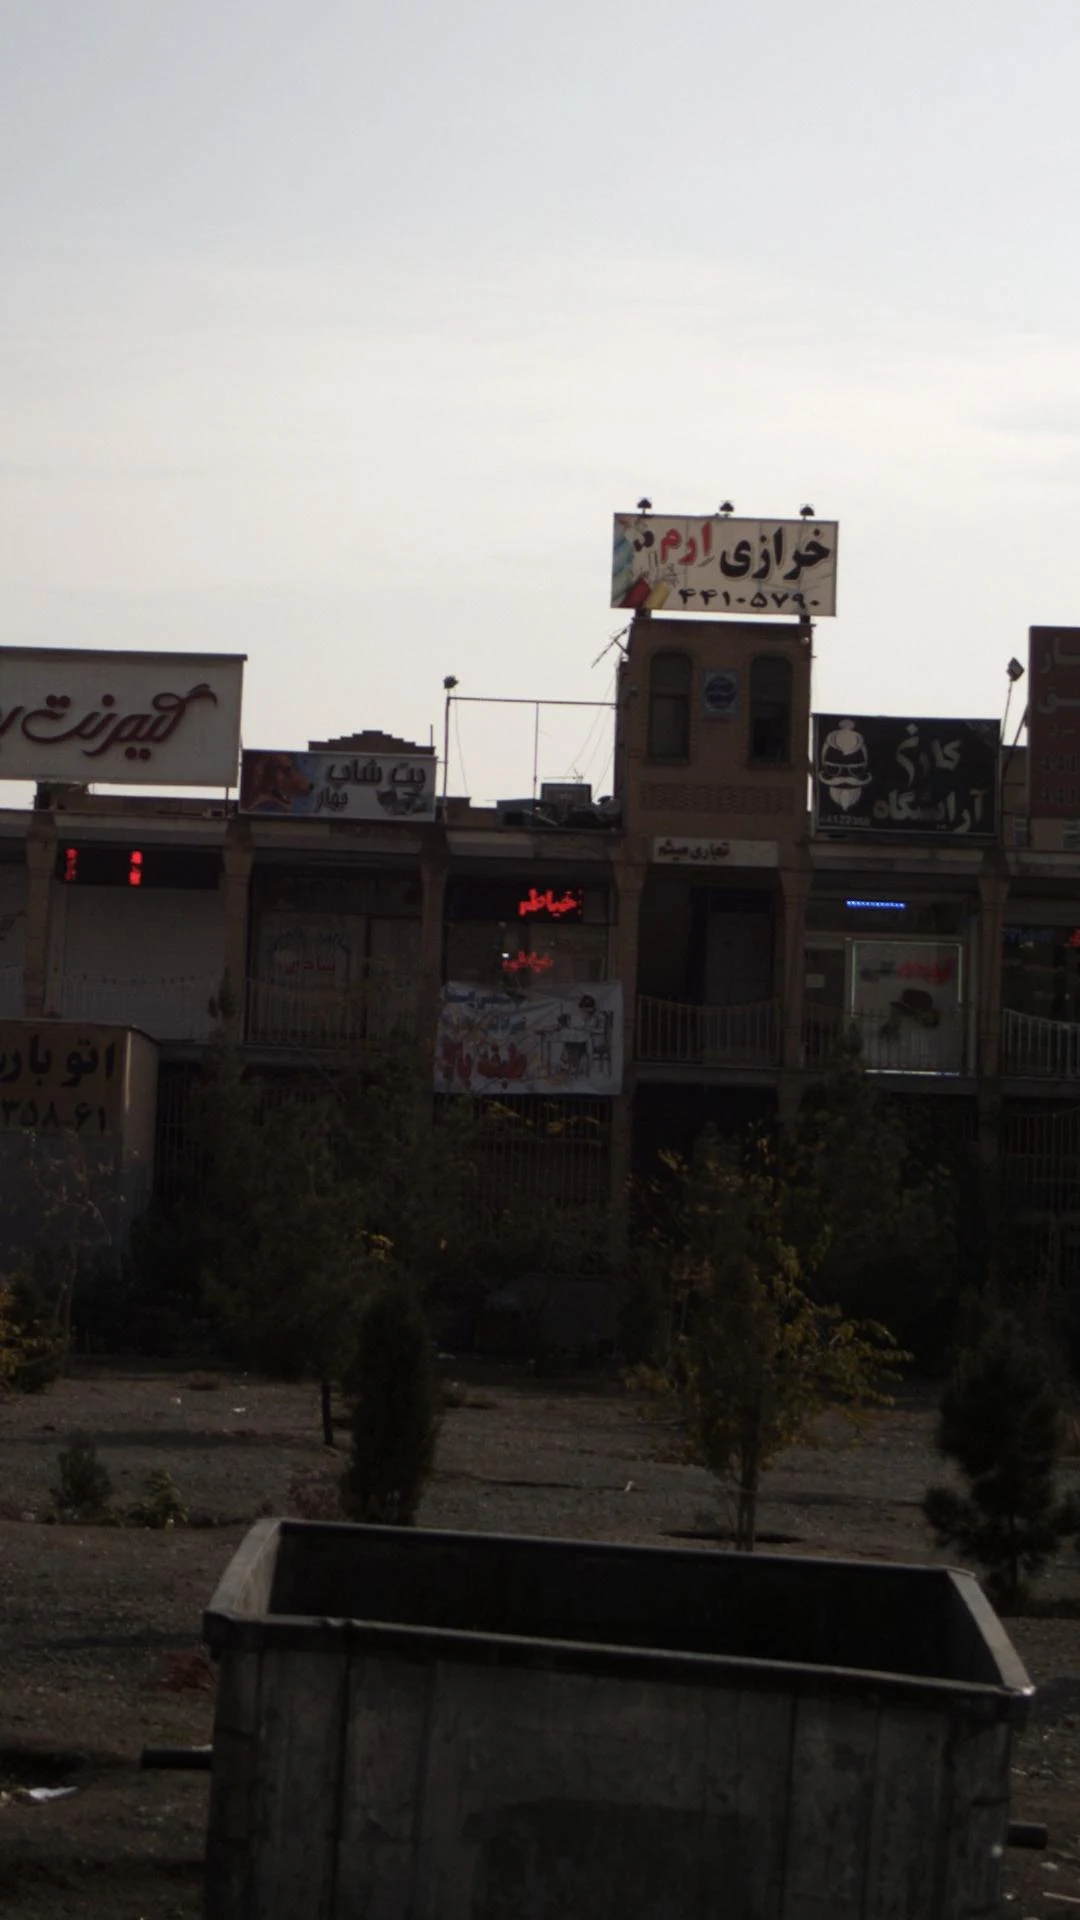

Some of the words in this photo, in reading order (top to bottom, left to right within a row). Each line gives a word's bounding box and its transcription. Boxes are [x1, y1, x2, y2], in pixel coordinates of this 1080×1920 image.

[661, 521, 713, 565] ارم
[719, 527, 830, 580] خرازی
[326, 757, 383, 790] شاپ
[390, 762, 426, 793] پت
